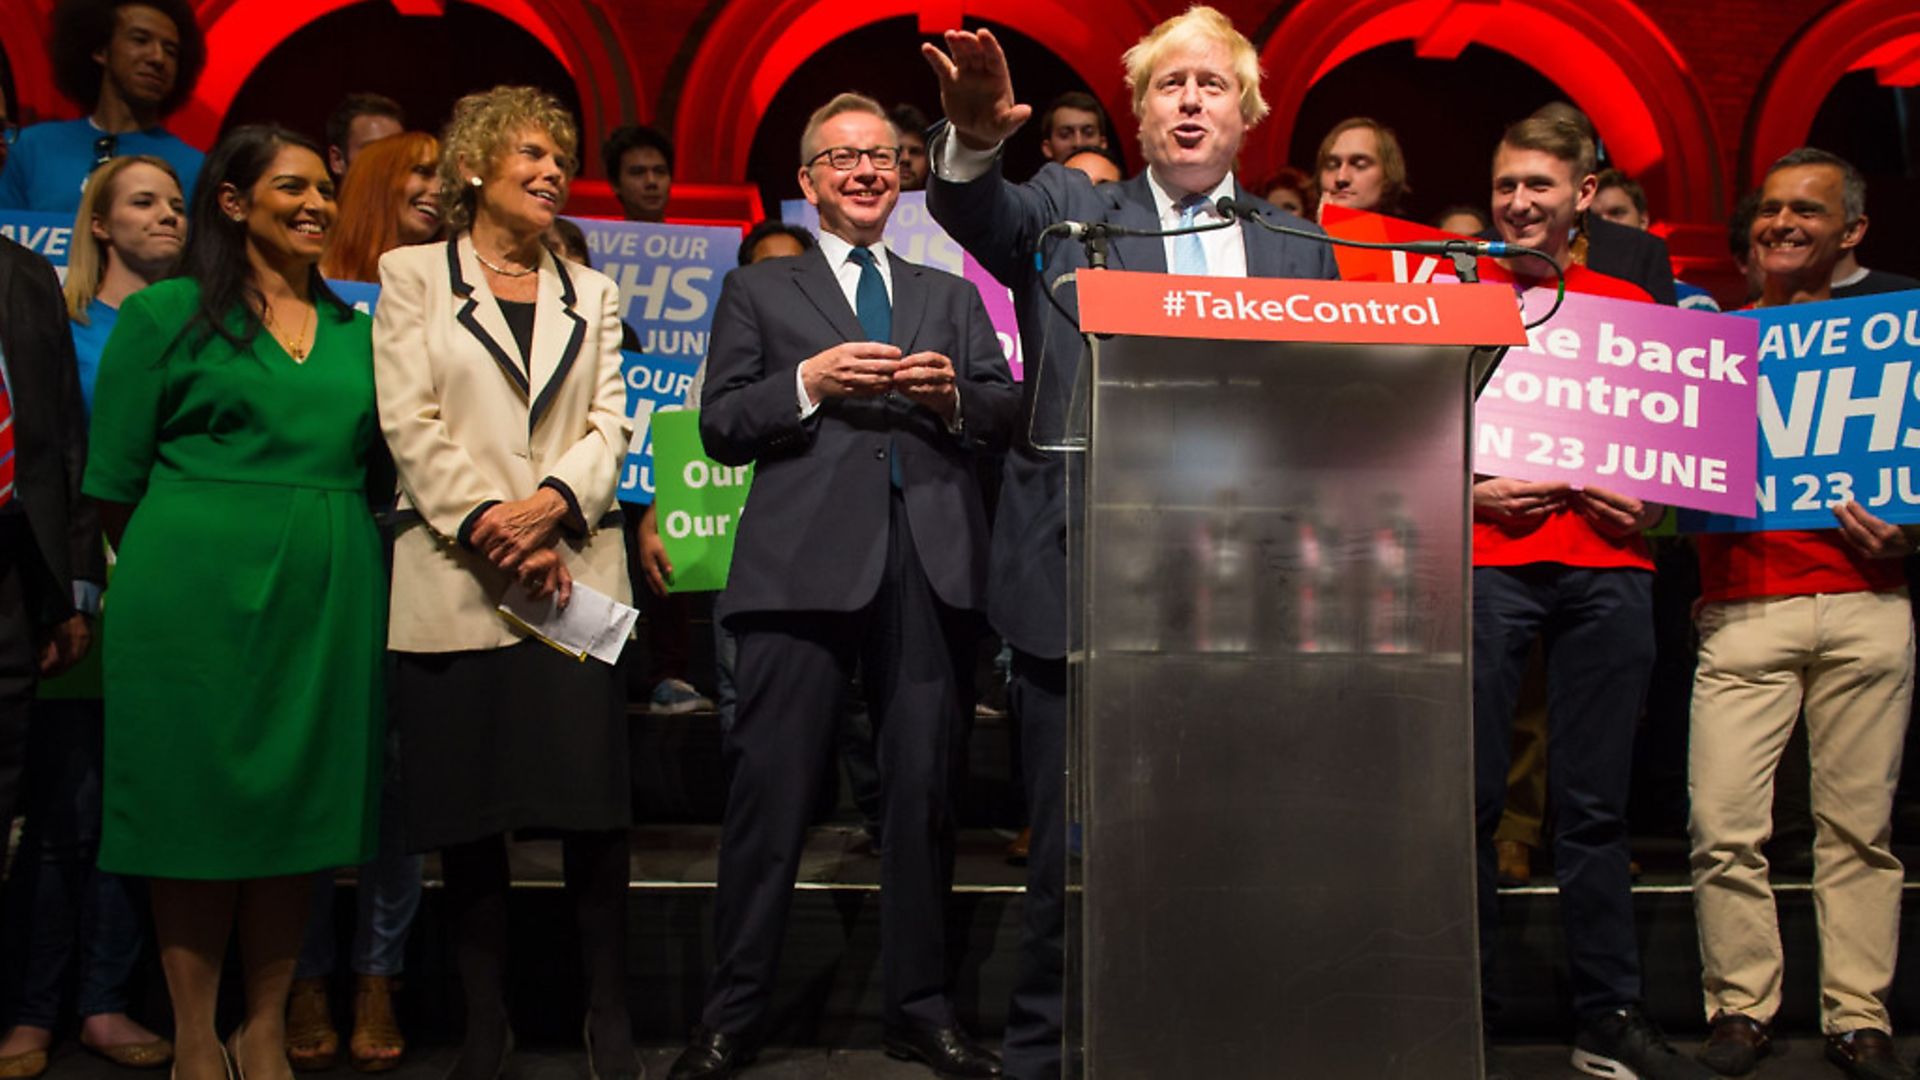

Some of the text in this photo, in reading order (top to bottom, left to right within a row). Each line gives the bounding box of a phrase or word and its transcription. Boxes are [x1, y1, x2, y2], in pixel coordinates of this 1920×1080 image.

[644, 234, 709, 260] OUR
[1163, 289, 1440, 325] #TakeControl
[641, 330, 711, 355] JUN
[1597, 322, 1748, 385] back
[1758, 317, 1852, 362] AVE
[627, 365, 695, 398] OUR
[683, 460, 749, 488] Our
[1525, 431, 1586, 470] 23
[1596, 443, 1728, 493] JUNE
[1791, 471, 1856, 511] 23
[666, 510, 731, 539] Our
